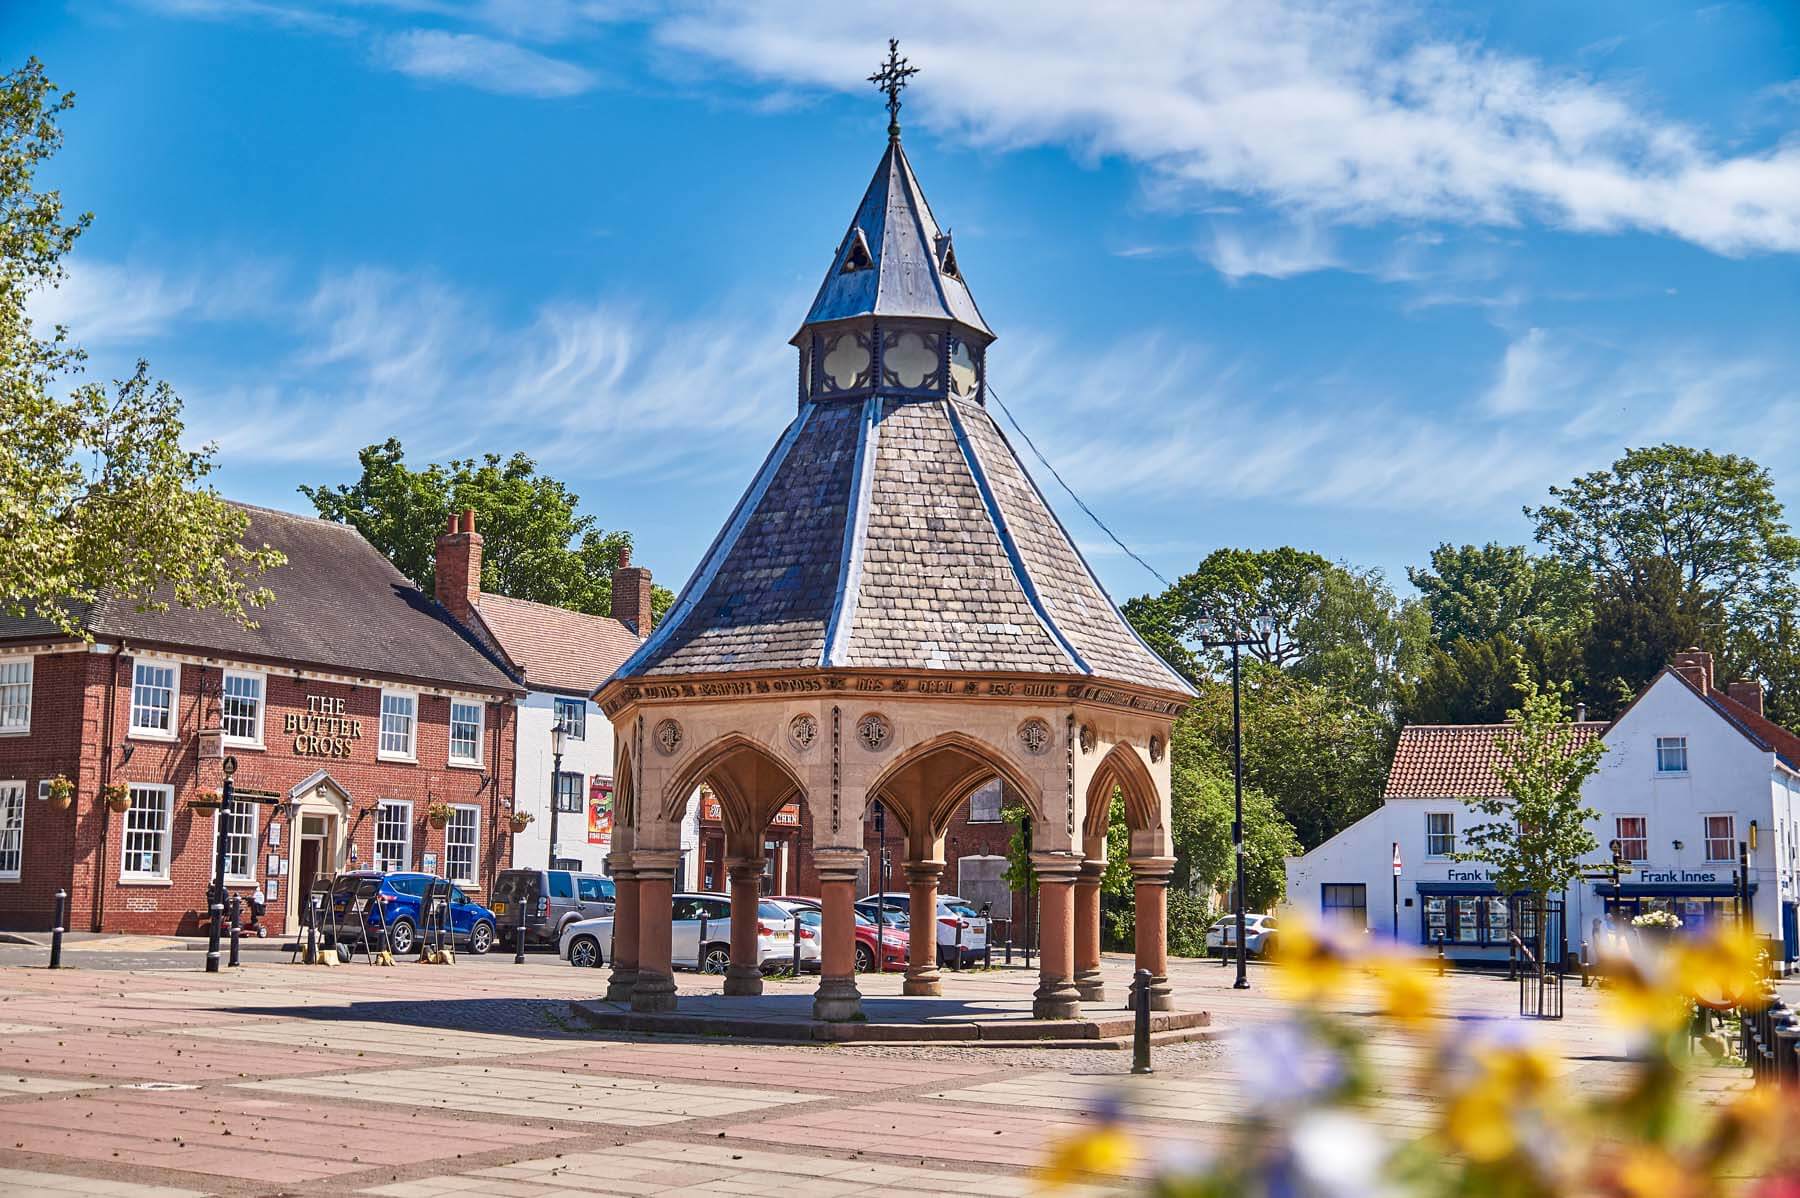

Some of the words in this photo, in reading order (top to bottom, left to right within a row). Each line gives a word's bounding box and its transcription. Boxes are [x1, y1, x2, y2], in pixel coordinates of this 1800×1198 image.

[306, 694, 346, 715] THE
[285, 713, 362, 737] BUTTER
[295, 734, 353, 757] CROSS
[1448, 869, 1482, 881] Frank
[1641, 870, 1678, 882] Frank
[1681, 870, 1716, 882] Innes
